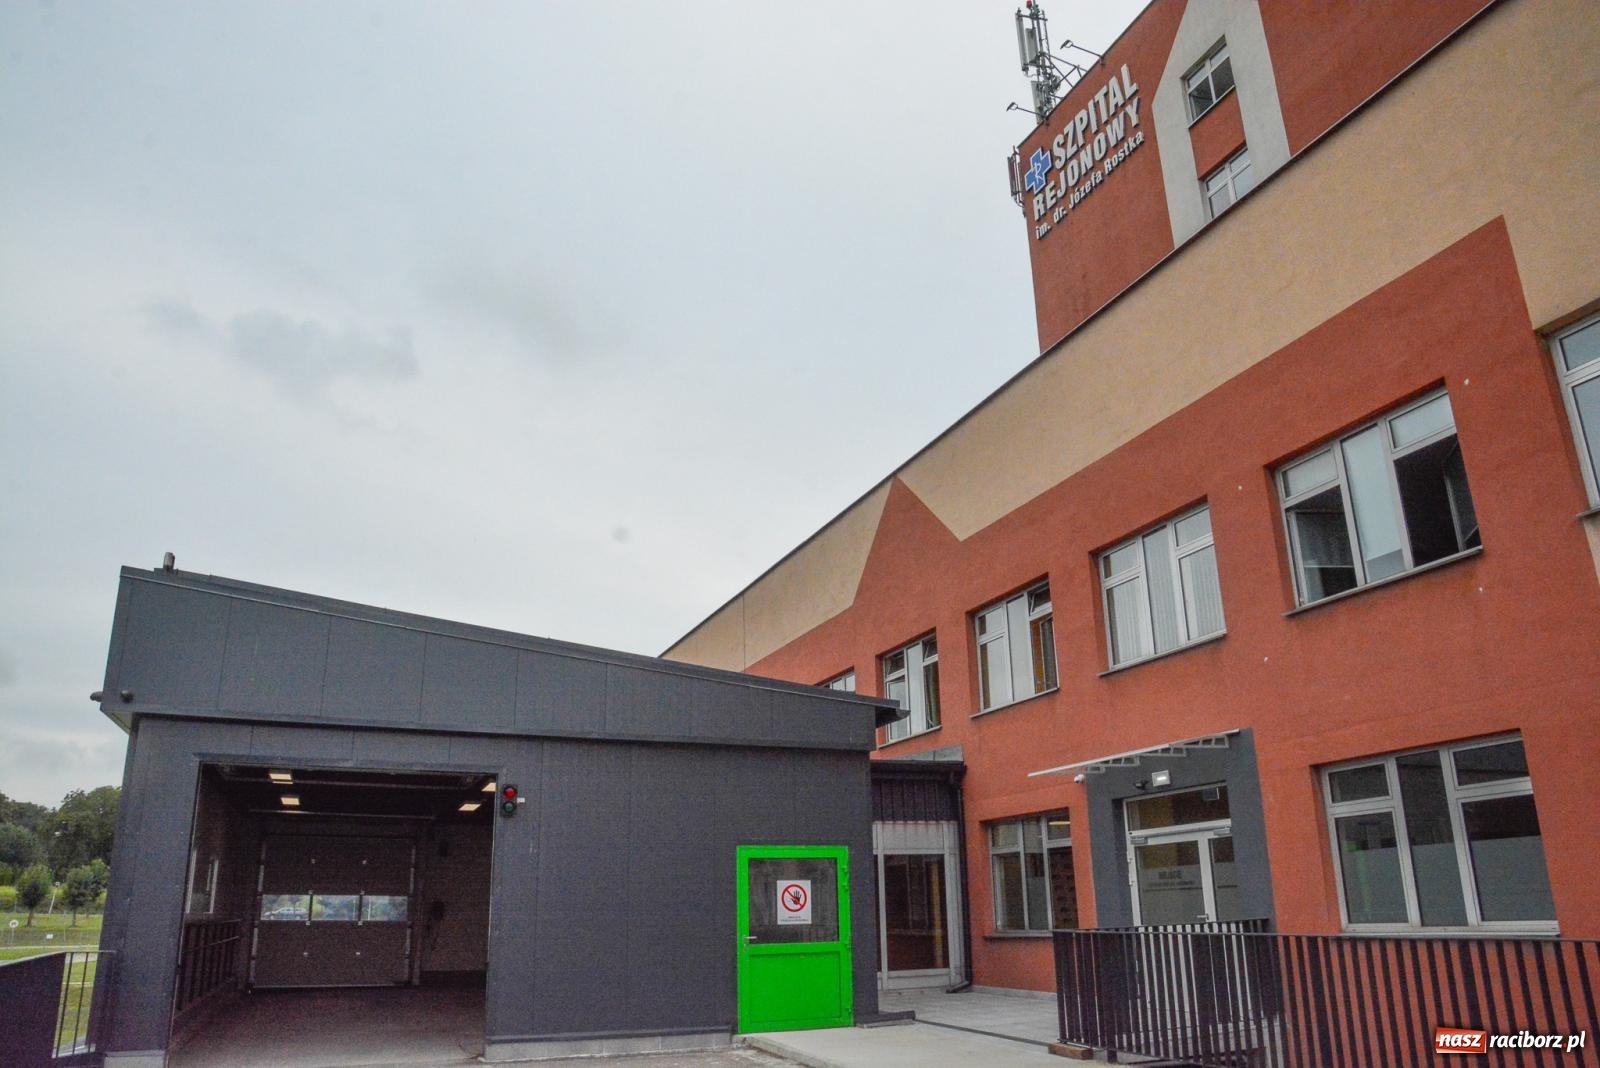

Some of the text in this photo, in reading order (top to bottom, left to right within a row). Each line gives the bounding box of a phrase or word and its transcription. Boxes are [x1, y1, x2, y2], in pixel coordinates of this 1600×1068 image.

[1033, 96, 1140, 221] REJONOWY
[1053, 64, 1138, 169] SZPITAL
[1035, 131, 1144, 240] im. dr. Józefa Rostka
